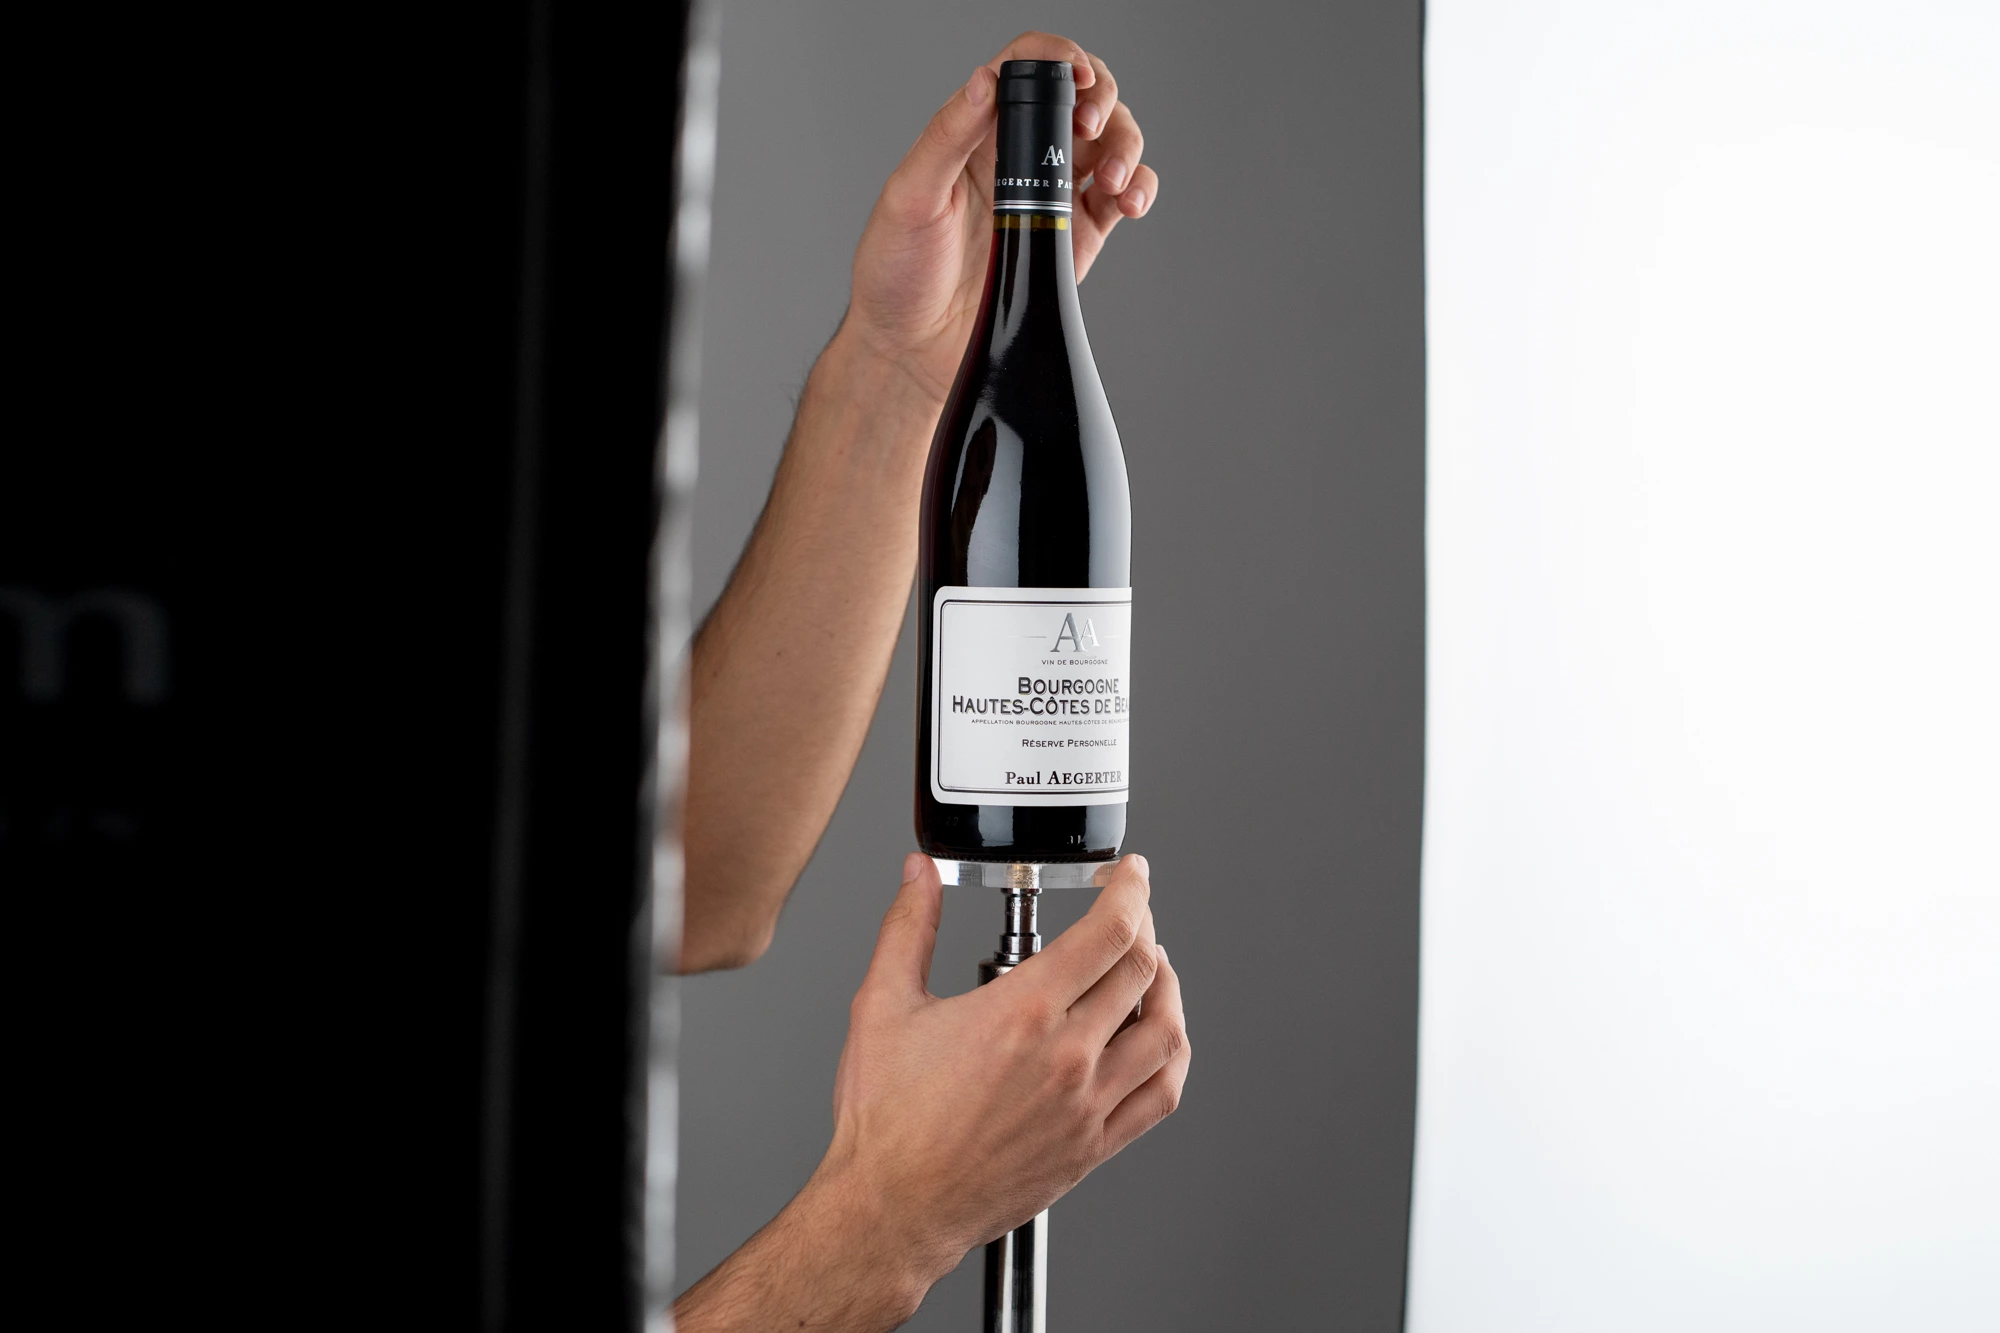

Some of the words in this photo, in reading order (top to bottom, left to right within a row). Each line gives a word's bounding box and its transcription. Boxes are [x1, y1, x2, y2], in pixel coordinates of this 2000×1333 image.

[1050, 612, 1101, 653] AA
[1018, 677, 1119, 695] BOURGOGNE
[952, 694, 1090, 716] HAUTES-CÔTES
[1094, 698, 1111, 715] DE
[1022, 738, 1065, 748] RÉSERVE
[1067, 738, 1117, 748] PERSONNELLE
[1005, 771, 1041, 785] Paul
[1046, 770, 1122, 786] AEGERTER
